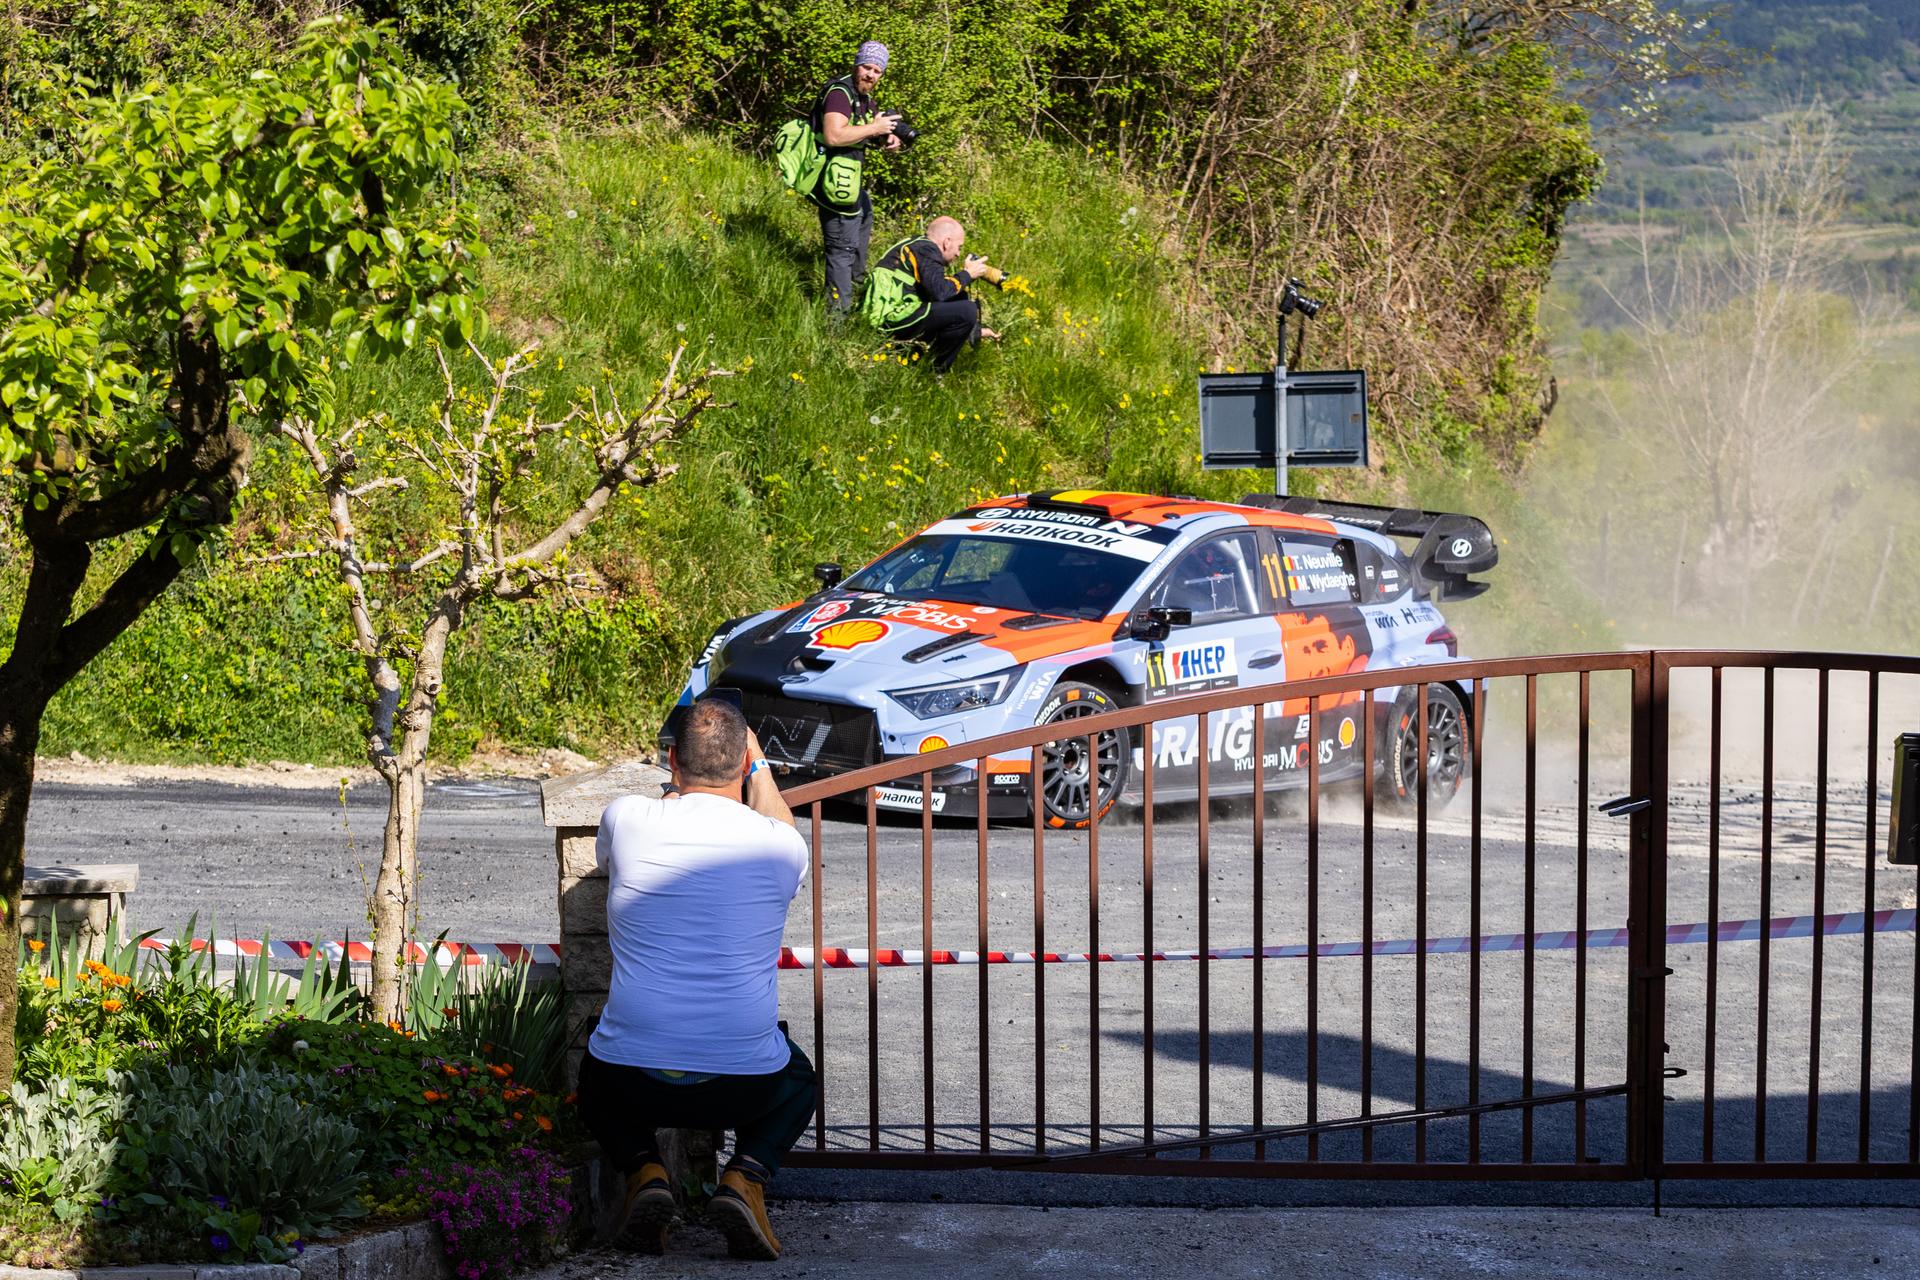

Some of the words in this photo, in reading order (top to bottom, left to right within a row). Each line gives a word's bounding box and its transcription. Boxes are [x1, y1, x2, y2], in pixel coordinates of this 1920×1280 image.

[1011, 508, 1101, 527] HYUNDAI
[1261, 552, 1287, 599] 11
[1292, 555, 1303, 571] T.
[1304, 552, 1344, 569] Neuville
[1296, 575, 1311, 592] M.
[1309, 571, 1356, 593] Wydaeghe
[859, 603, 977, 630] MOBIS
[1146, 651, 1167, 689] 11
[1190, 645, 1226, 678] HEP
[1133, 716, 1254, 772] CRAIG
[1234, 753, 1278, 772] HYUDAI
[1278, 738, 1334, 771] MOIS
[882, 791, 941, 807] HanKOK
